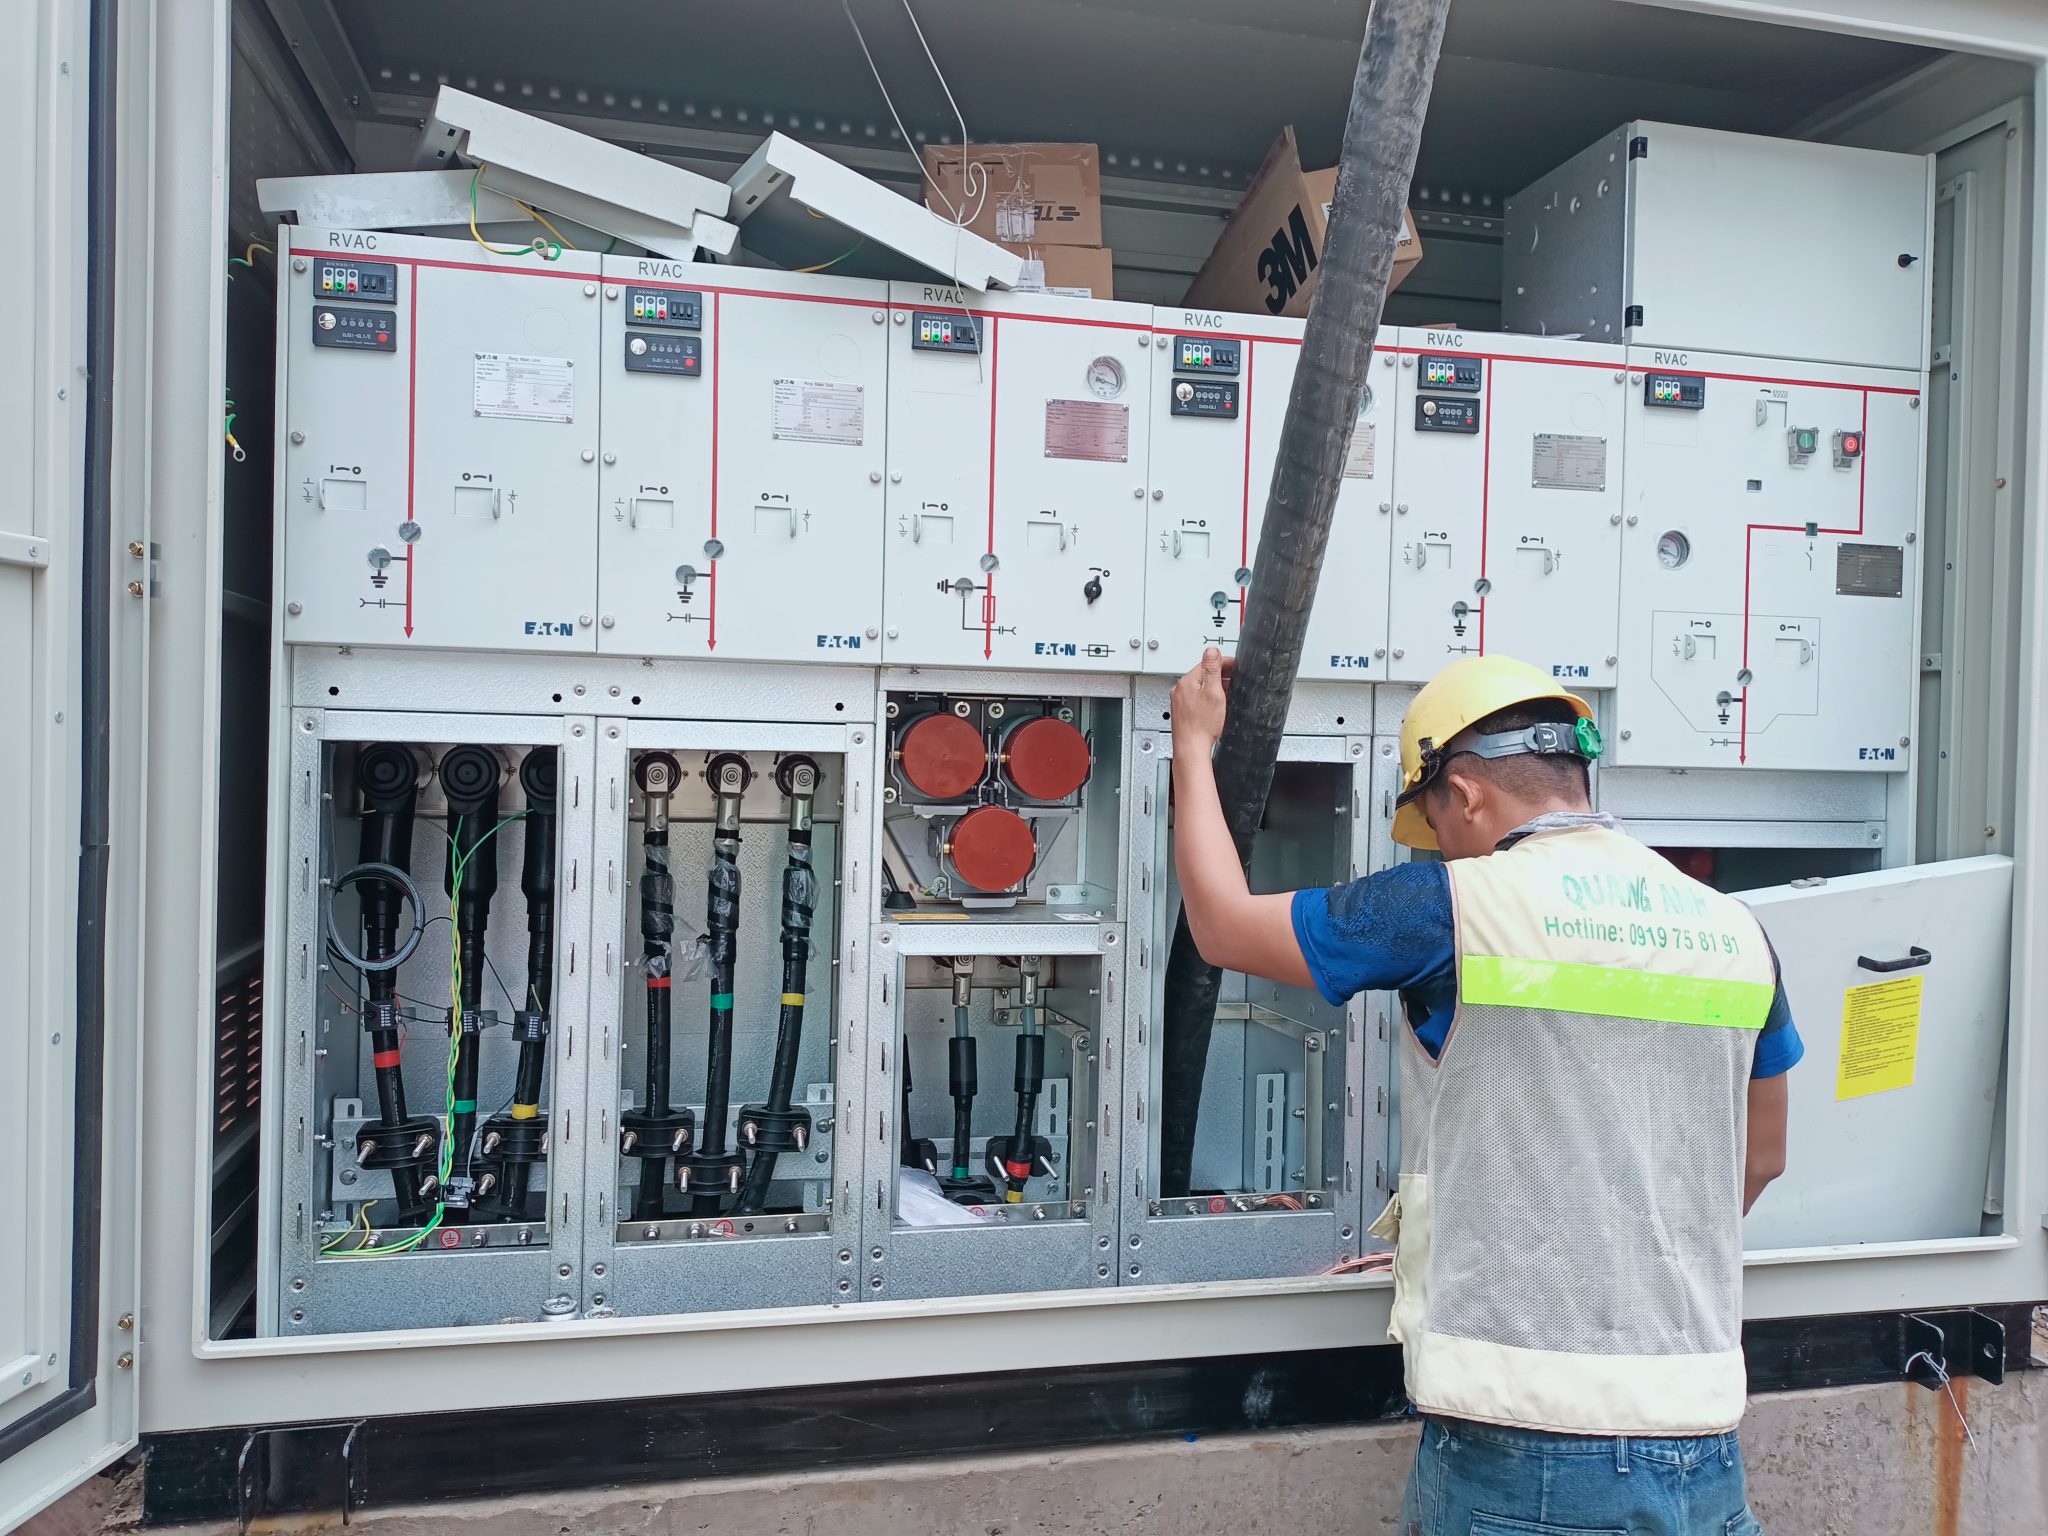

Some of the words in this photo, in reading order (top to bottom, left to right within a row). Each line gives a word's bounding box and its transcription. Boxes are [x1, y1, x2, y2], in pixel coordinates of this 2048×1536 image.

[329, 232, 377, 250] RVAC
[1257, 203, 1319, 315] 3M
[638, 261, 682, 279] RVAC
[923, 287, 965, 304] RVAC
[1184, 312, 1223, 328] RVAC
[1427, 332, 1463, 347] RVAC
[1654, 351, 1688, 366] RVAC
[1543, 916, 1624, 943] Hotline:
[1629, 923, 1668, 949] 0919
[1672, 928, 1694, 951] 75
[1699, 931, 1717, 953] 81
[1722, 934, 1740, 955] 91
